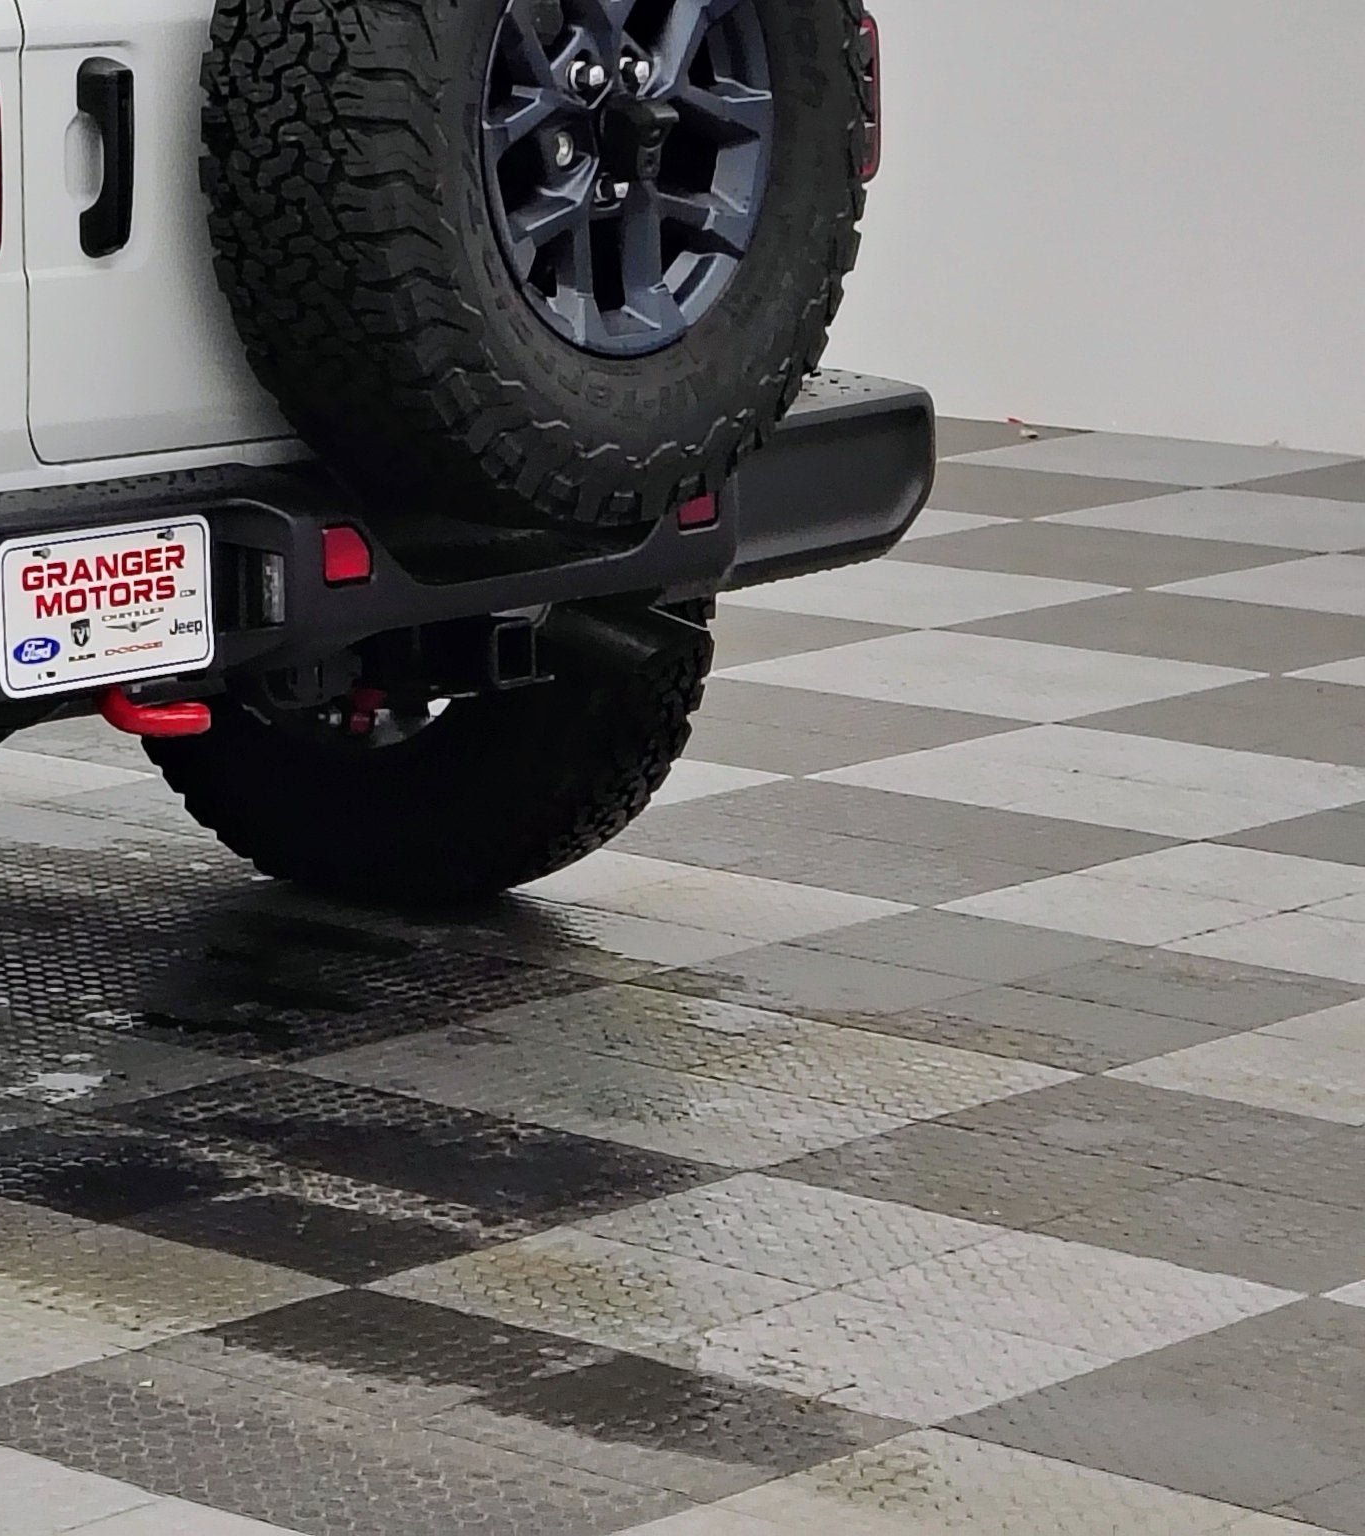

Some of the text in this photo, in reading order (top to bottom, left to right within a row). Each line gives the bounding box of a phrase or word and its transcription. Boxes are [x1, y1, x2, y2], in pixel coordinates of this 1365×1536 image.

[21, 544, 186, 592] GRANGER
[35, 575, 176, 619] MOTORS
[169, 618, 203, 636] Jeep
